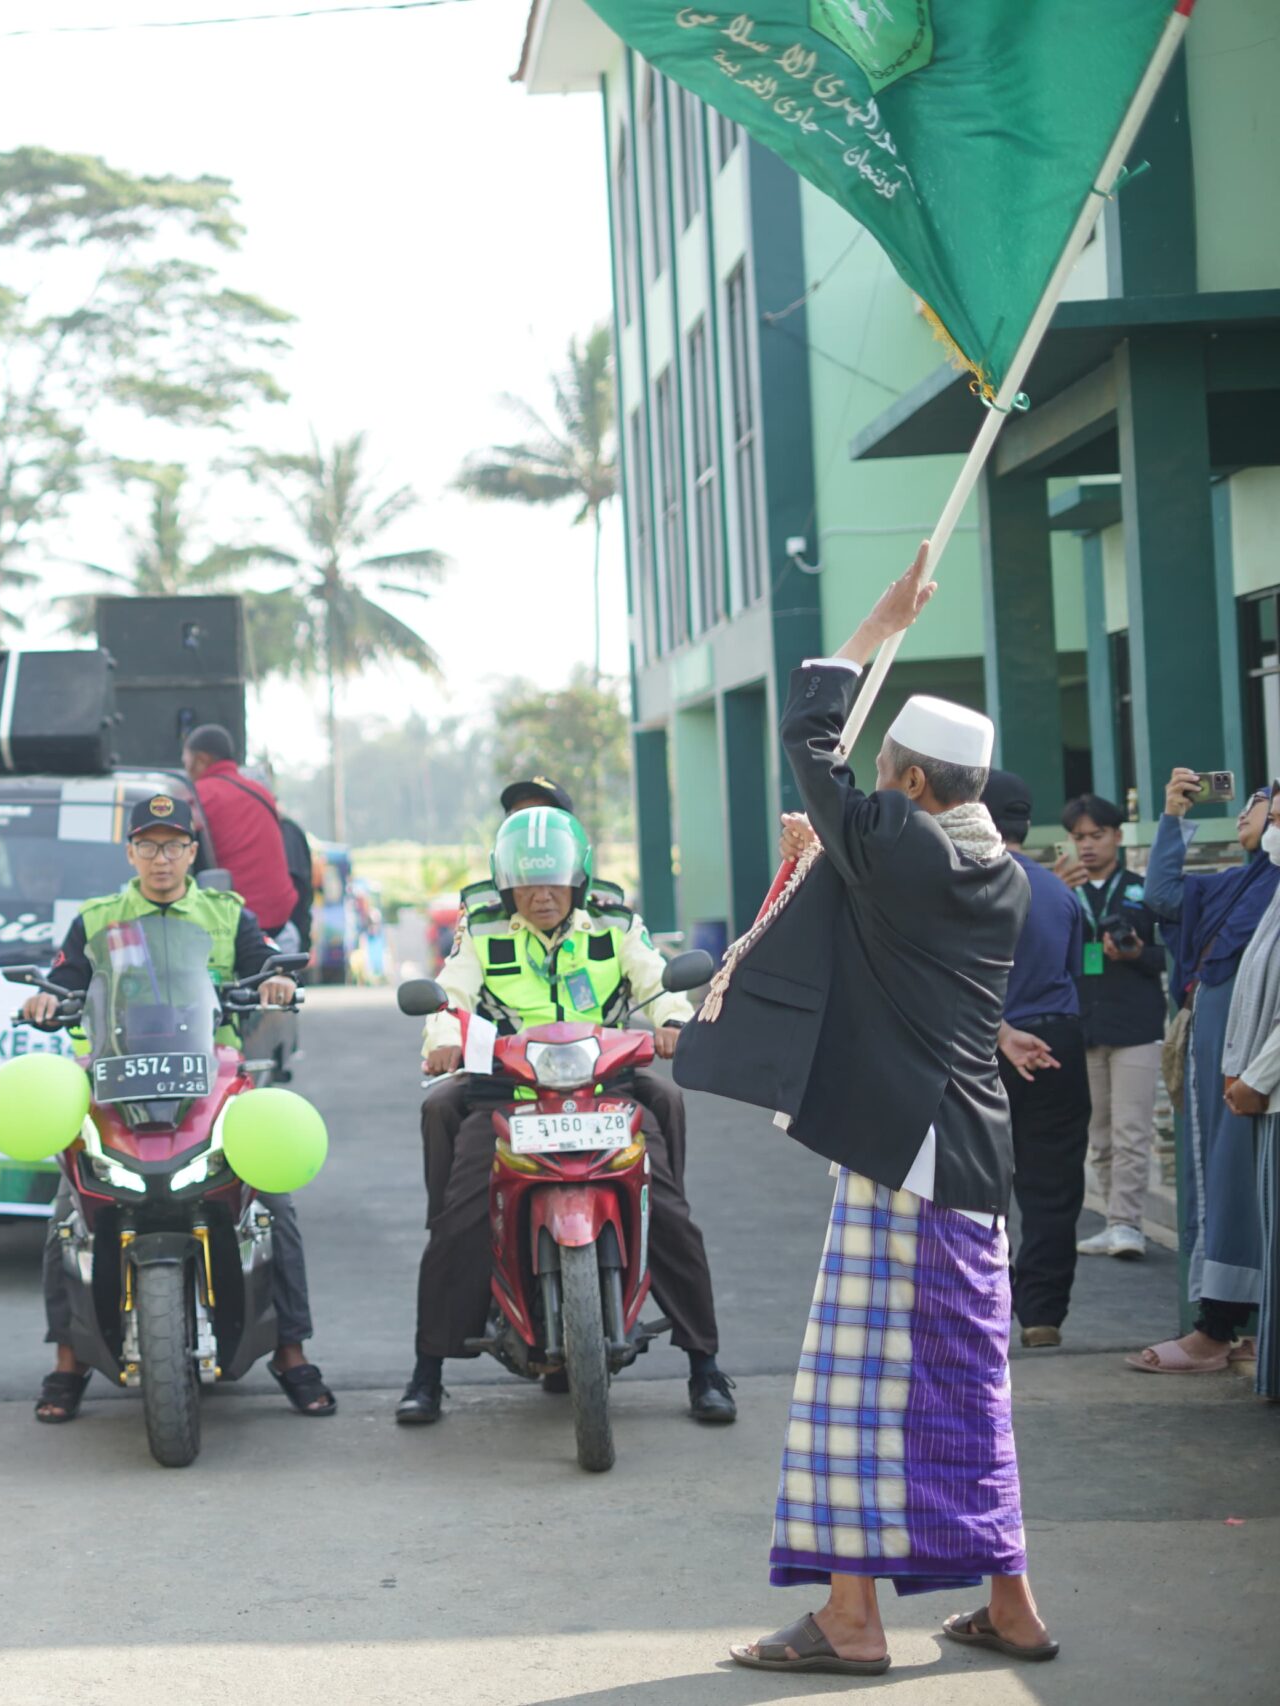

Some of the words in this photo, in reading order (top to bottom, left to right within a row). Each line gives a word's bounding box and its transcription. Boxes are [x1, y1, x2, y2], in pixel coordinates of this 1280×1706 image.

[518, 854, 558, 871] Grab
[96, 1063, 107, 1081] E
[125, 1057, 171, 1077] 5574
[514, 1120, 524, 1135] E
[537, 1117, 582, 1135] 5160
